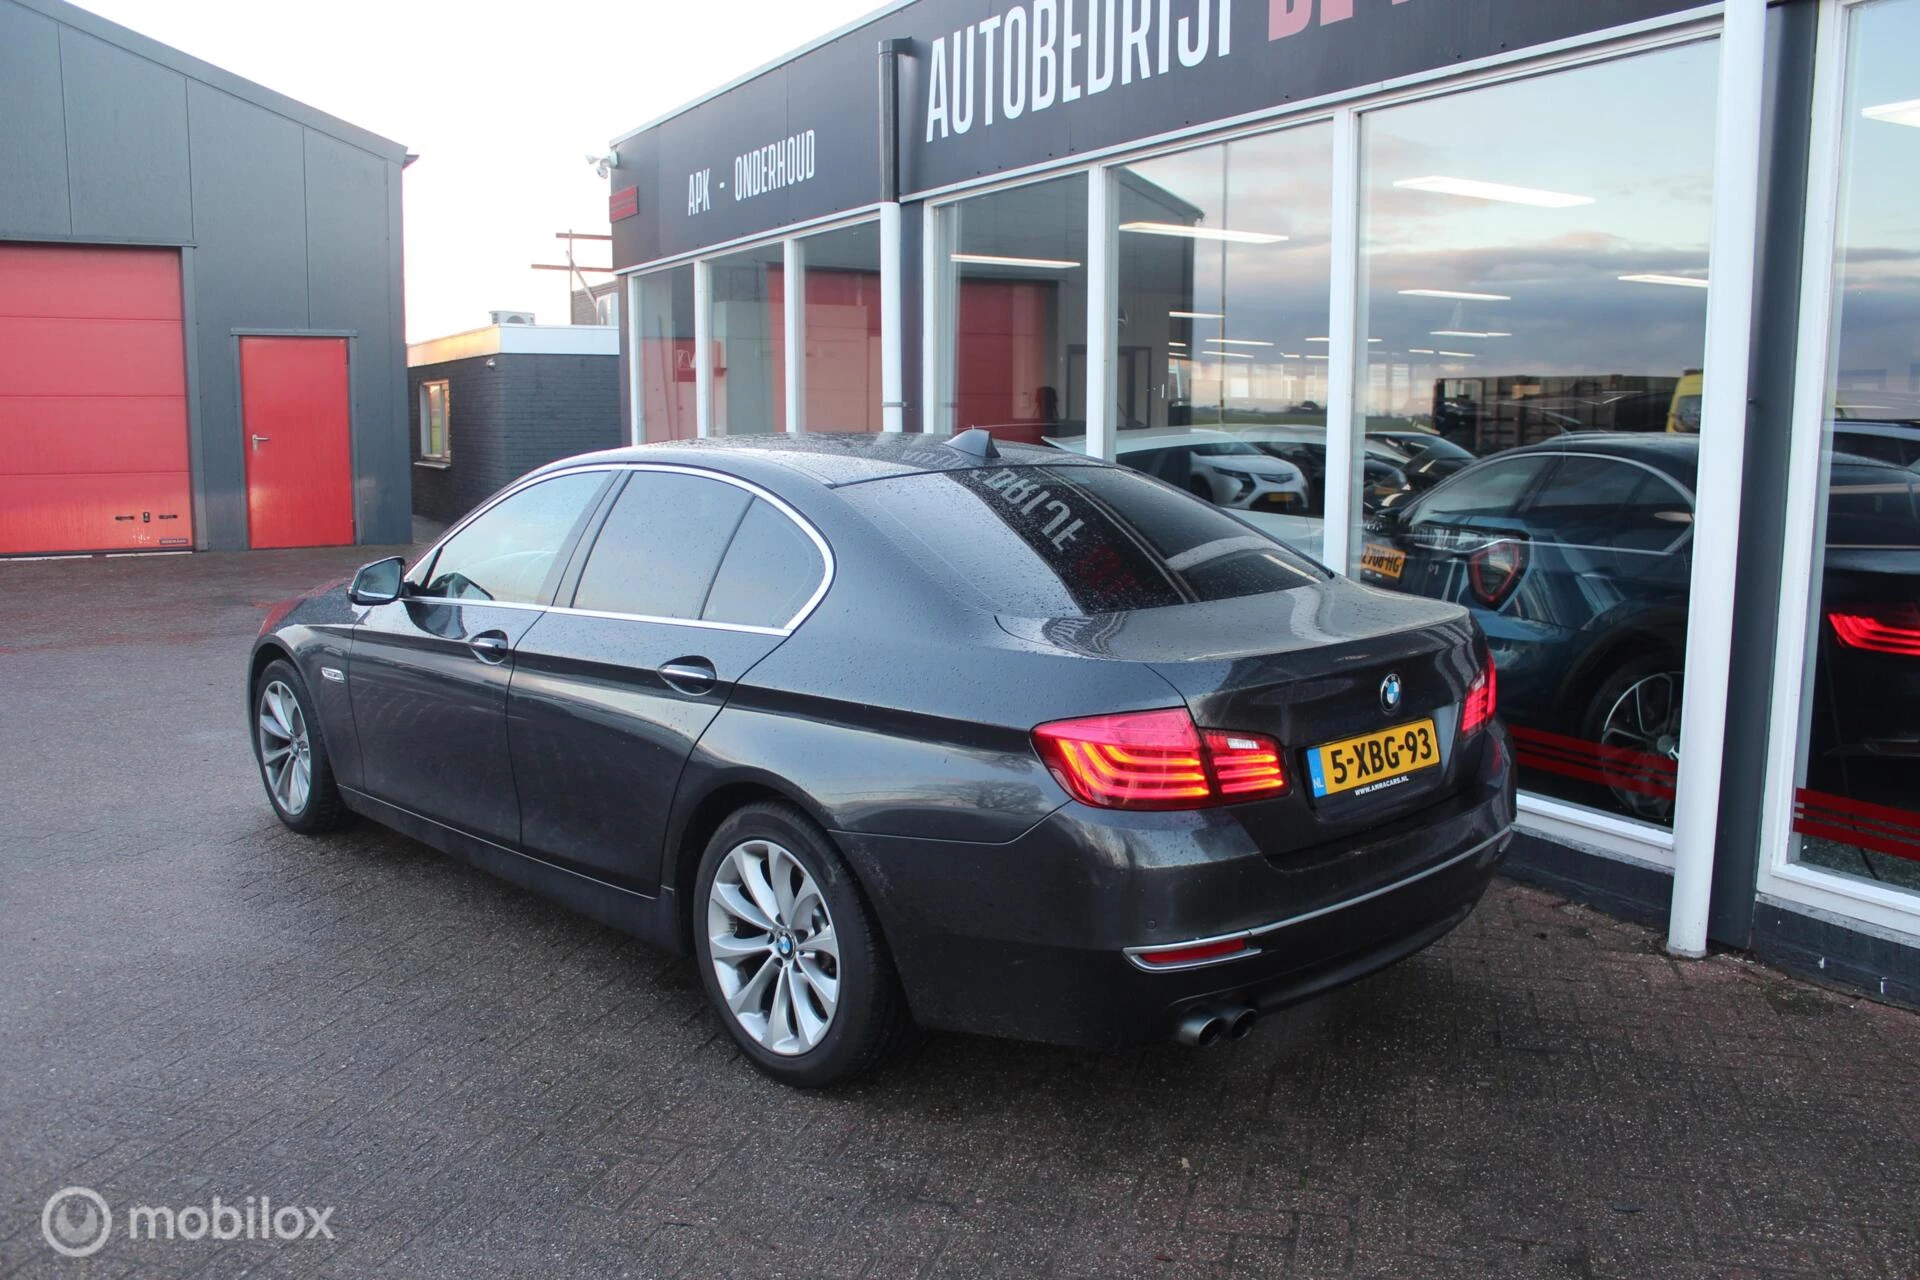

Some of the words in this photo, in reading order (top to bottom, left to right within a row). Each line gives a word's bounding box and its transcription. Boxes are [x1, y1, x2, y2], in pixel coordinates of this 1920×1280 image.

[687, 167, 711, 217] APK
[734, 128, 816, 202] ONDERHOUD
[1313, 777, 1325, 789] NL
[1330, 727, 1432, 785] 5-XBG-93
